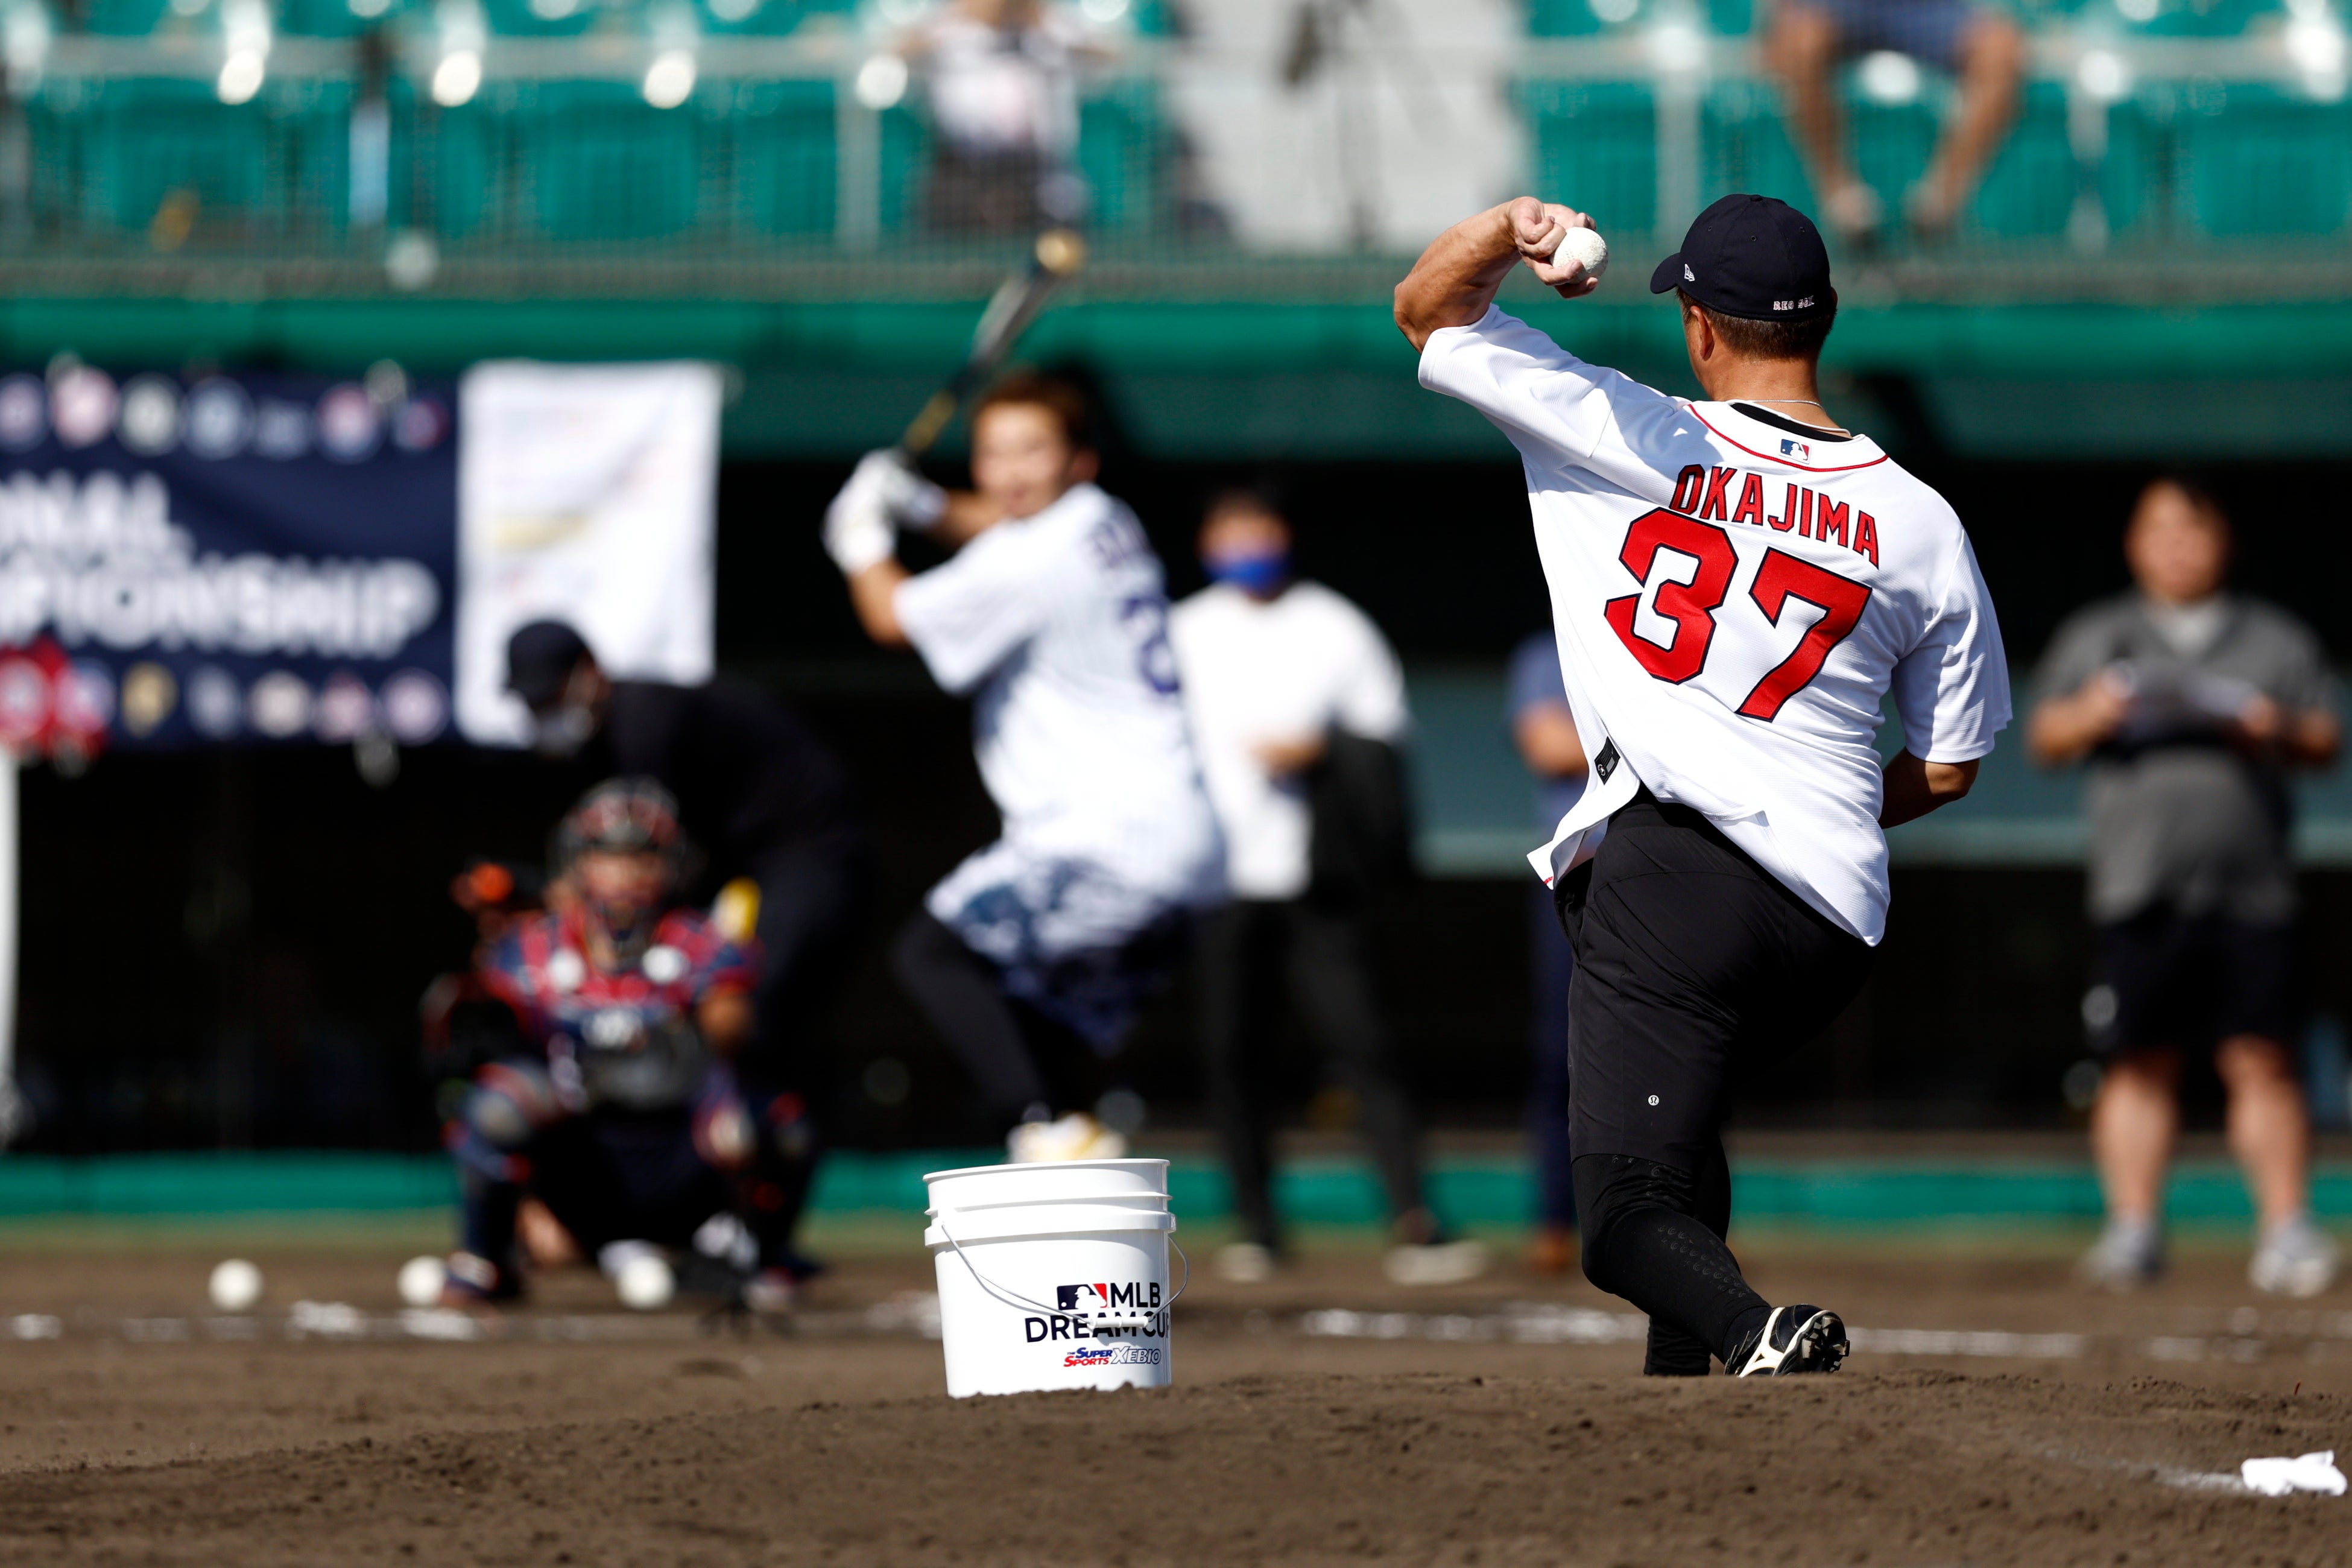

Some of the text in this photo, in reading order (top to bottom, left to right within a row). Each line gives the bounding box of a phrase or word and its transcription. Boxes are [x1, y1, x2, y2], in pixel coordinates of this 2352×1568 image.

[1668, 464, 1879, 569] OKAJIMA
[1604, 507, 1873, 723] 37
[1110, 1282, 1161, 1308] MLB
[1025, 1311, 1137, 1342] DREAM
[1063, 1355, 1110, 1367] SPORTS
[1075, 1347, 1113, 1359] SUPER
[1111, 1346, 1162, 1365] XEBIO
